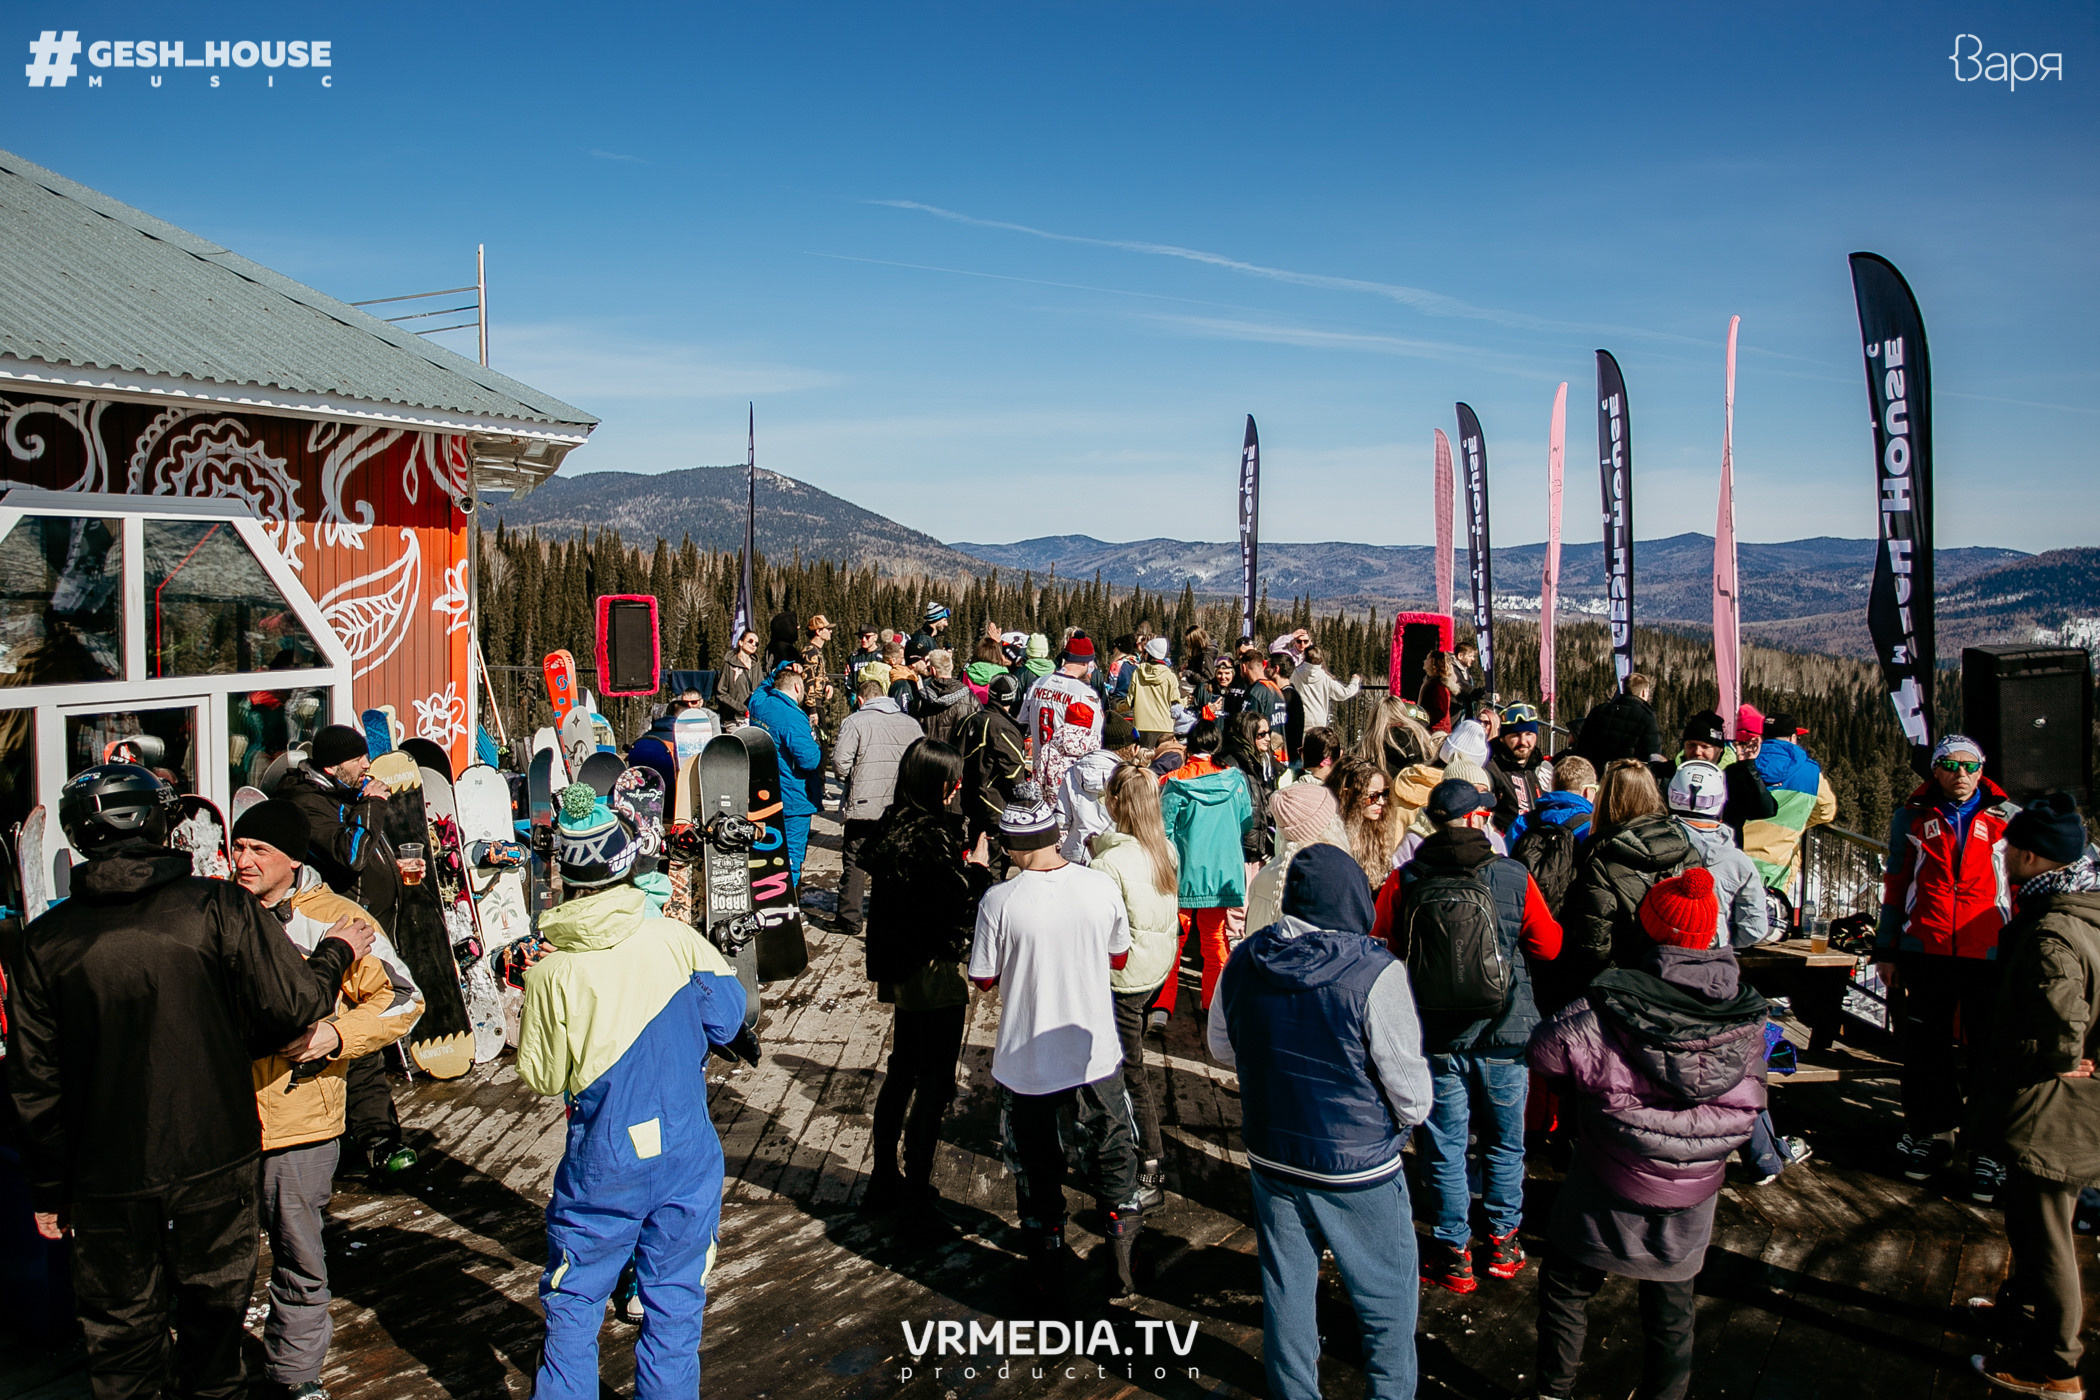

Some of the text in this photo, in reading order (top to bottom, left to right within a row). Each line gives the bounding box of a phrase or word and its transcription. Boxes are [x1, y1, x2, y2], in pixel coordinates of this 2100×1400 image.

[1033, 687, 1073, 706] OVECHKIN
[381, 771, 415, 785] SALOMON
[711, 892, 748, 910] ARBOR
[420, 1044, 454, 1060] SALOMON
